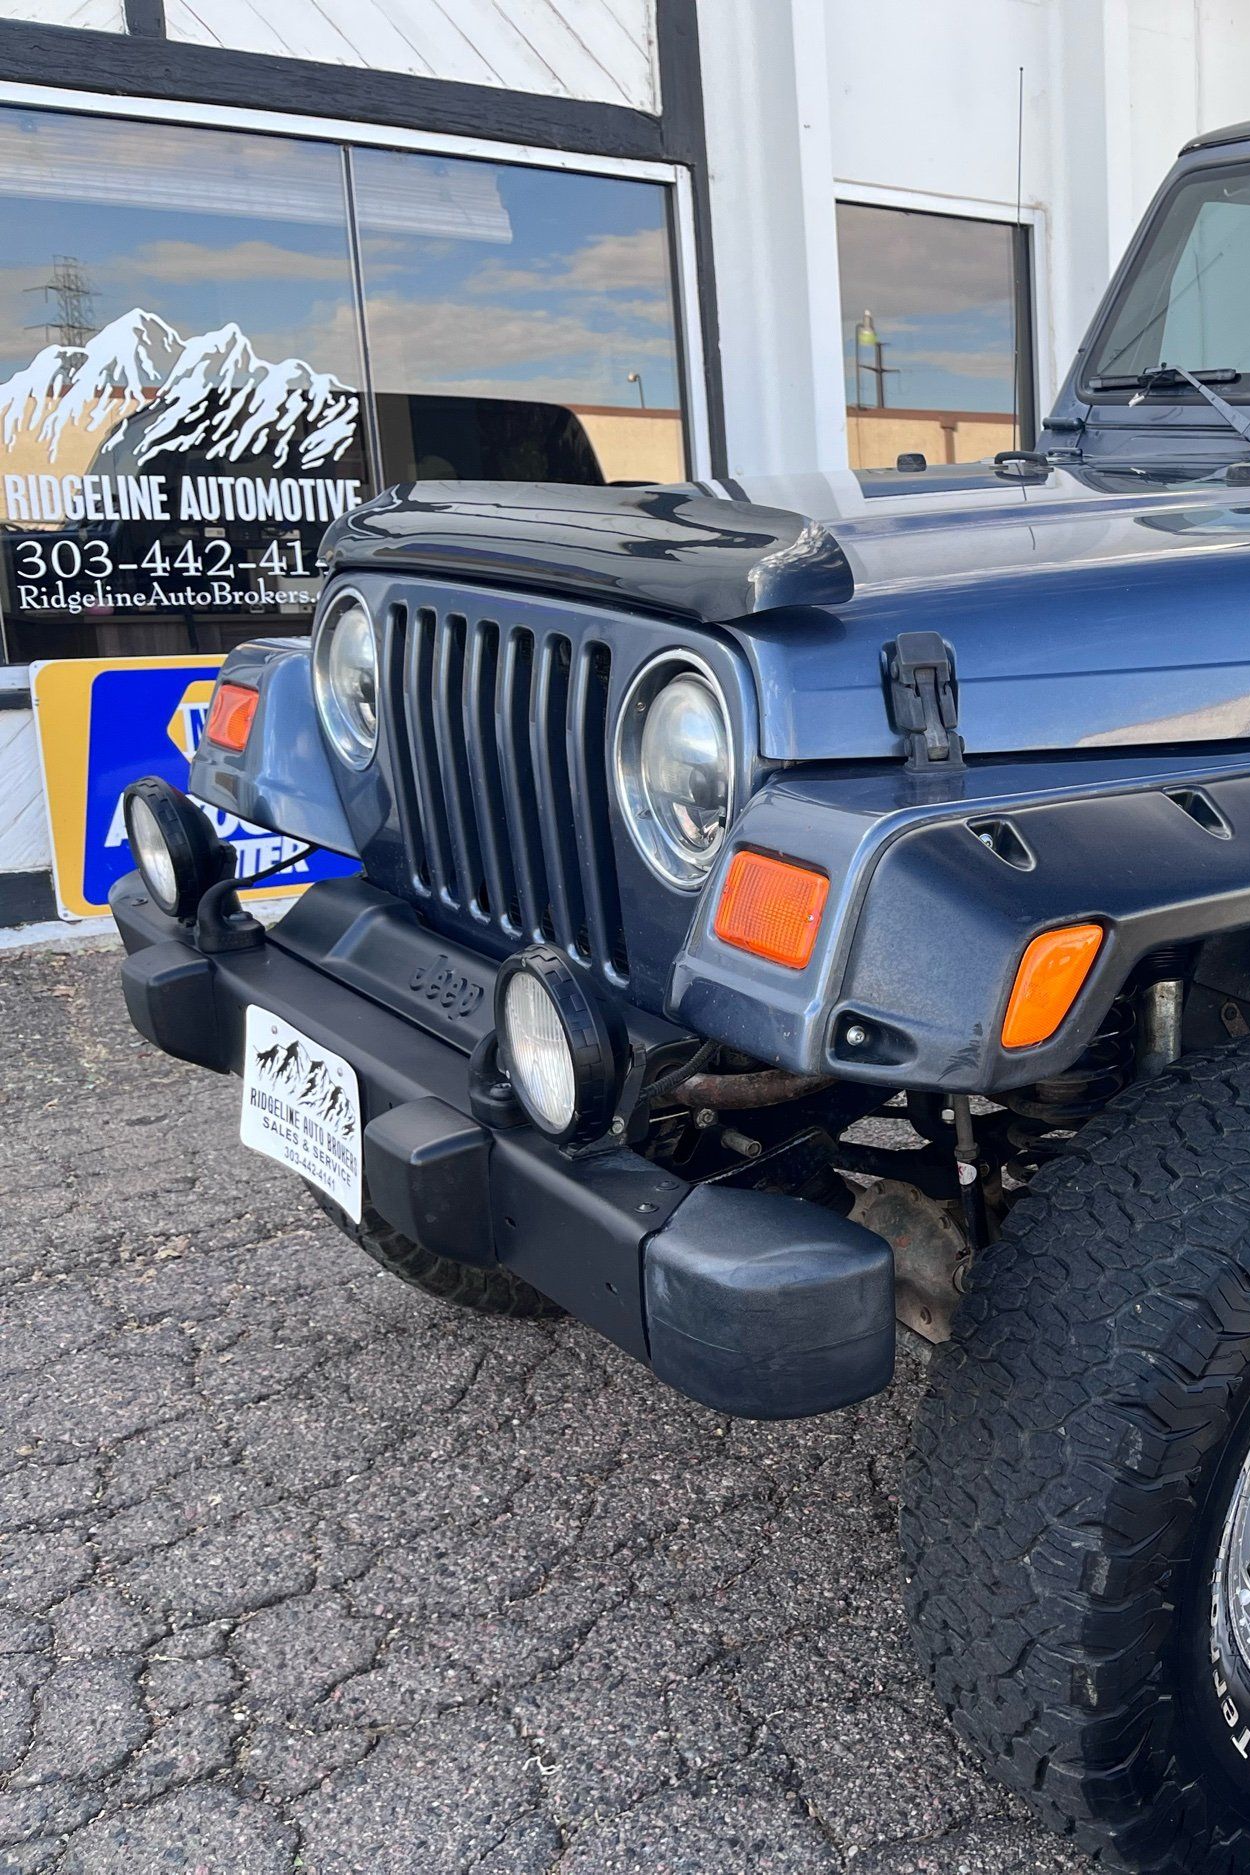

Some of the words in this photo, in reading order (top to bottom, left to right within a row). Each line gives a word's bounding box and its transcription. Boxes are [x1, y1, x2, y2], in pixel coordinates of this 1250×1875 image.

[4, 474, 171, 521] RIDGELINE
[180, 475, 363, 523] AUTOMOTIVE
[15, 540, 328, 579] 303-442-41
[409, 954, 485, 1021] Jeep
[250, 1087, 300, 1130] RIDGELINE
[303, 1115, 324, 1146] AUTO
[327, 1132, 358, 1177] BROKERS
[262, 1116, 299, 1145] SALES
[302, 1139, 310, 1152] &
[313, 1145, 352, 1187] SERVICE
[284, 1146, 336, 1191] 303-442-4141
